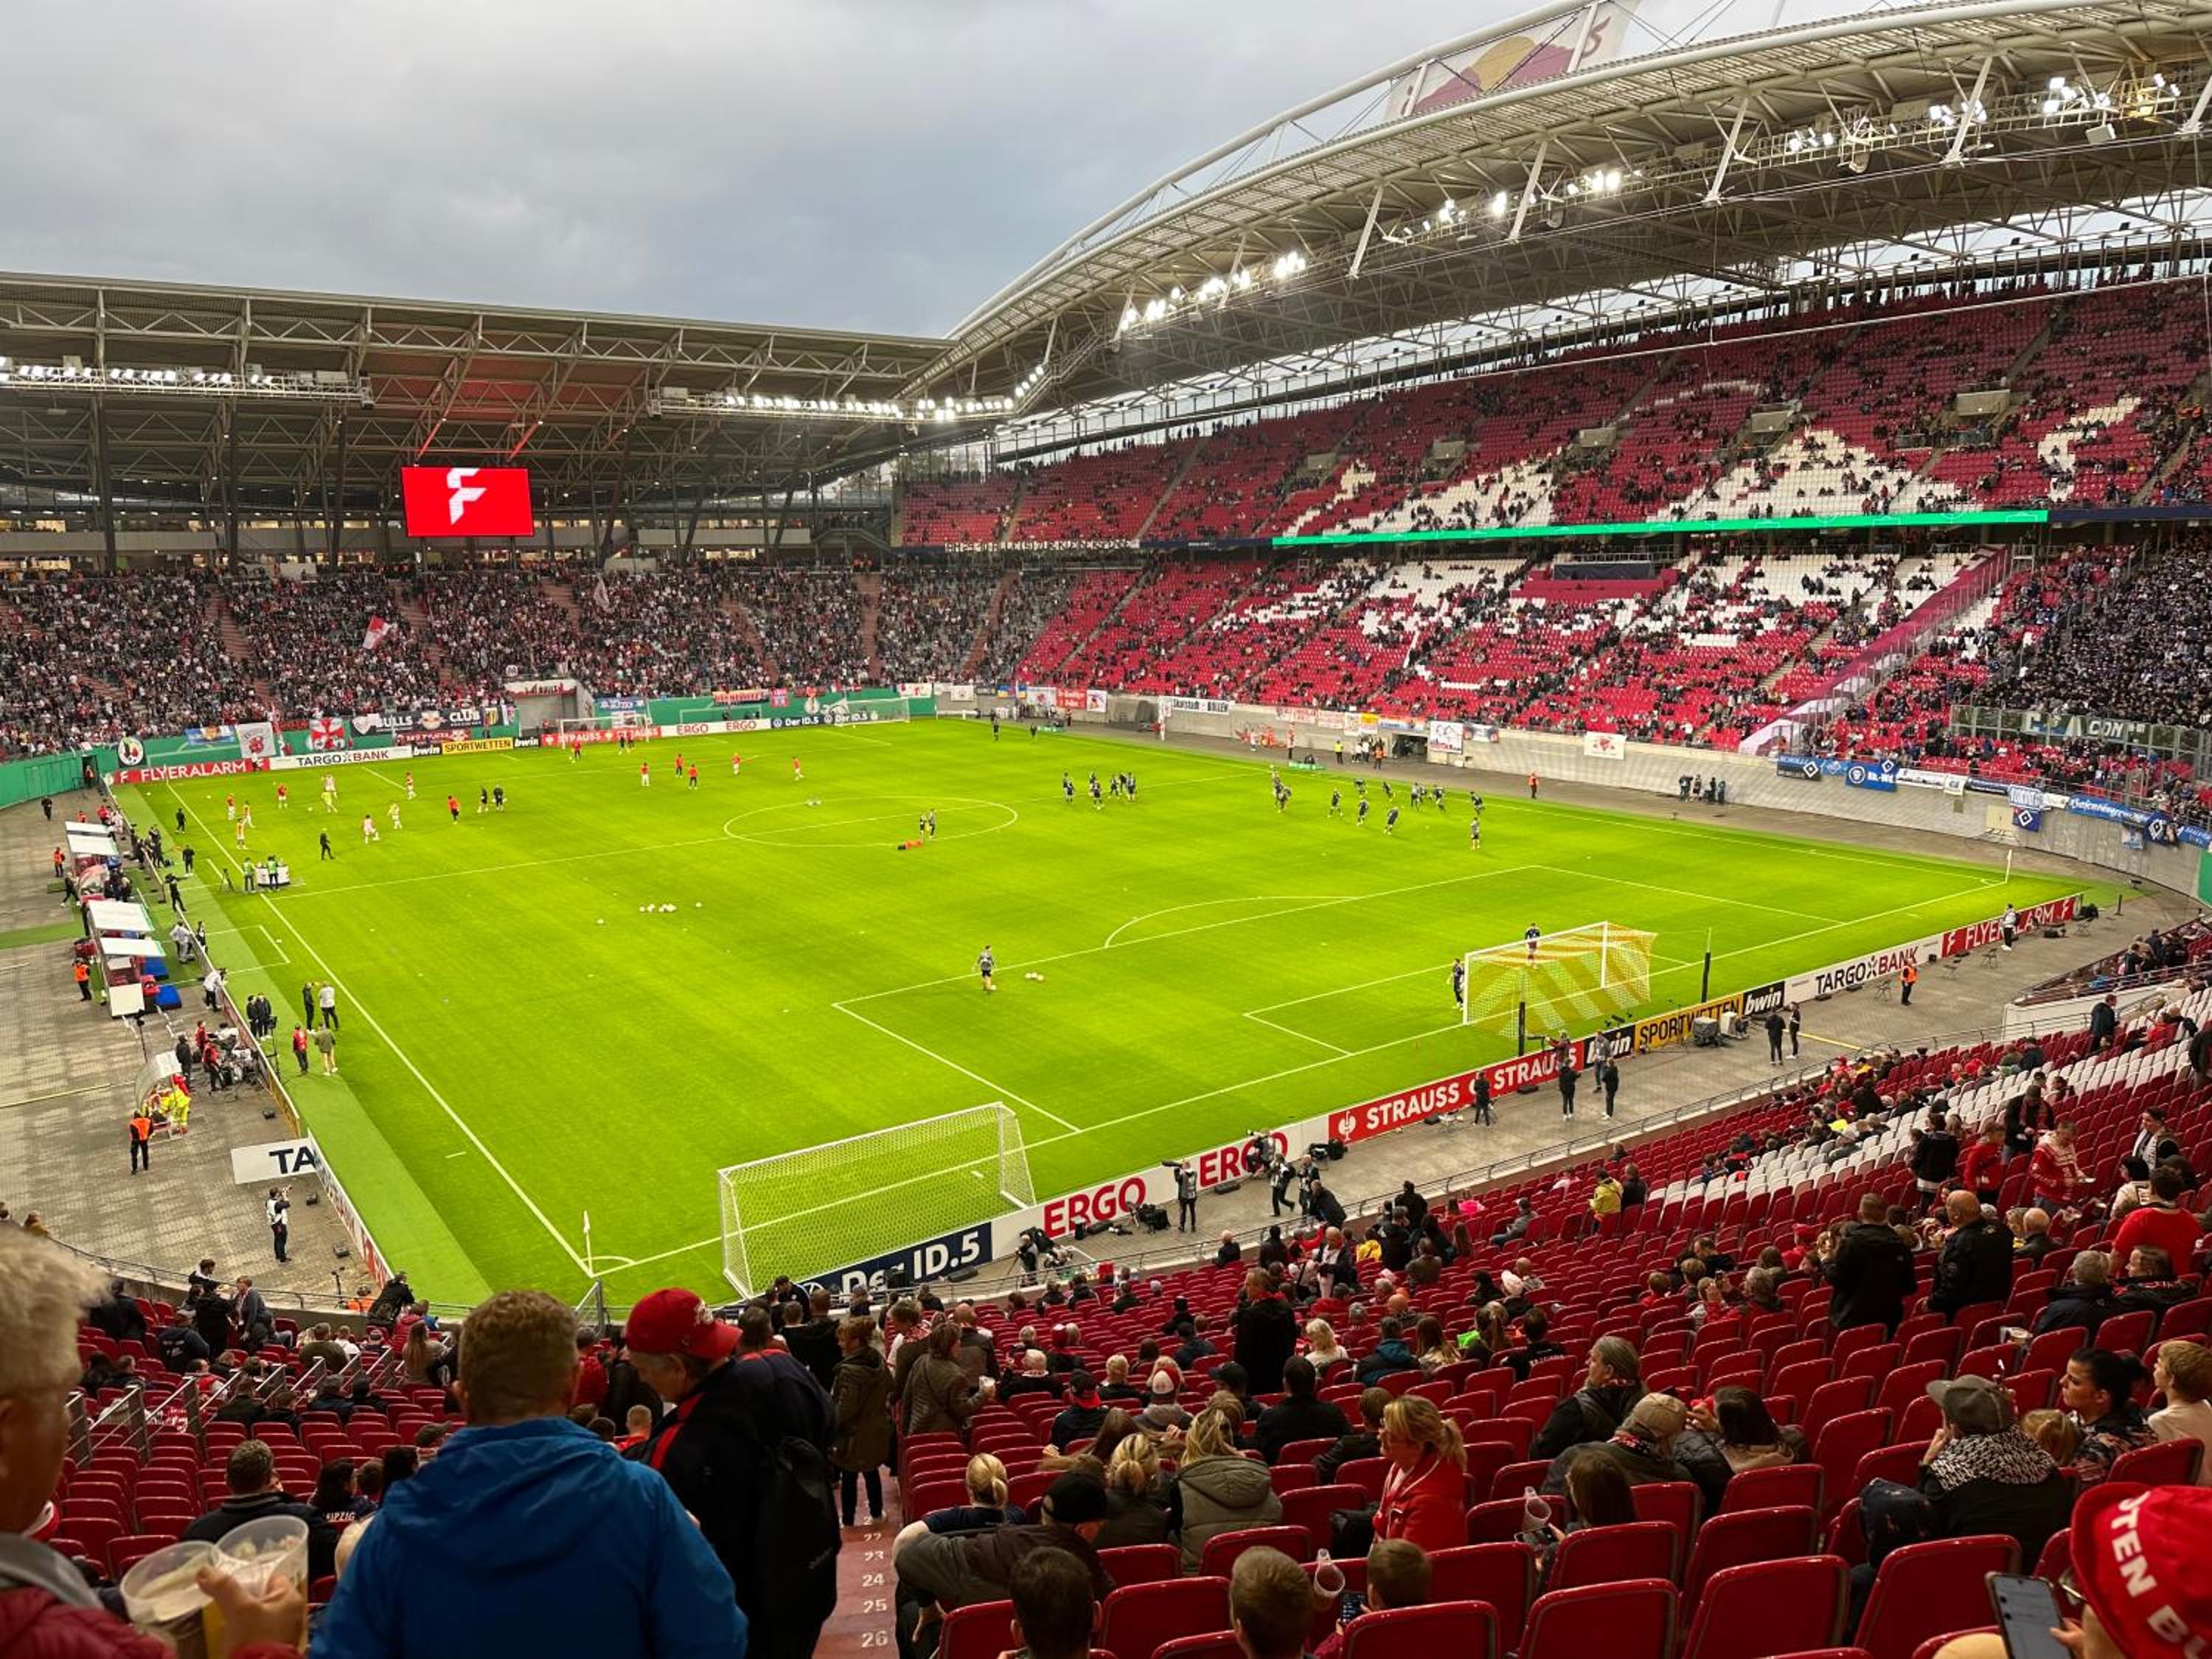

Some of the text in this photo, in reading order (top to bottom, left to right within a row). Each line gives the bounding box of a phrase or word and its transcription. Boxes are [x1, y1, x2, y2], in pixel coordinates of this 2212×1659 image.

[450, 709, 479, 722] CLUB
[677, 723, 709, 735] ERGO
[726, 720, 757, 731] ERGO
[444, 739, 511, 752] SPORTWETTEN
[515, 737, 539, 747] bwin
[414, 744, 440, 757] bwin
[141, 762, 246, 782] FLYERALARM
[1744, 987, 1781, 1016] bwin
[1366, 1082, 1460, 1130] STRAUSS
[1043, 1177, 1147, 1239] ERGO
[914, 1231, 981, 1280] ID.5
[863, 1533, 882, 1542] 22
[864, 1551, 885, 1562] 23
[861, 1573, 885, 1587] 24
[863, 1599, 887, 1613] 25
[861, 1630, 888, 1648] 26
